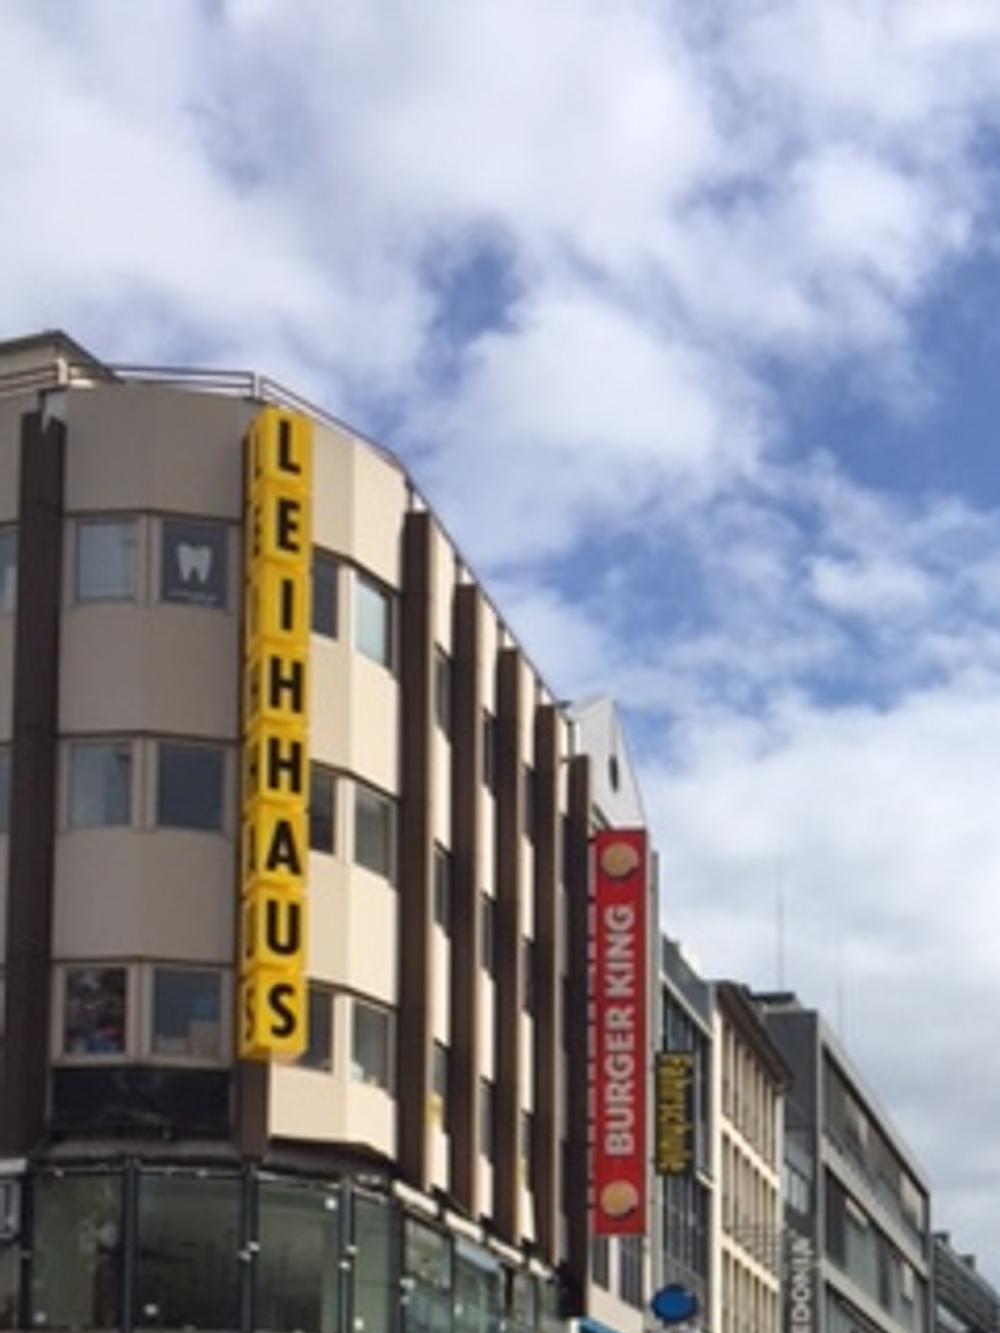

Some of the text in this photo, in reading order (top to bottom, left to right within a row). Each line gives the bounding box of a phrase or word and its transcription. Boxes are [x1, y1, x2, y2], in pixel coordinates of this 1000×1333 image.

[266, 419, 303, 1040] LEIHHAUS
[605, 904, 635, 1156] BURGER KING
